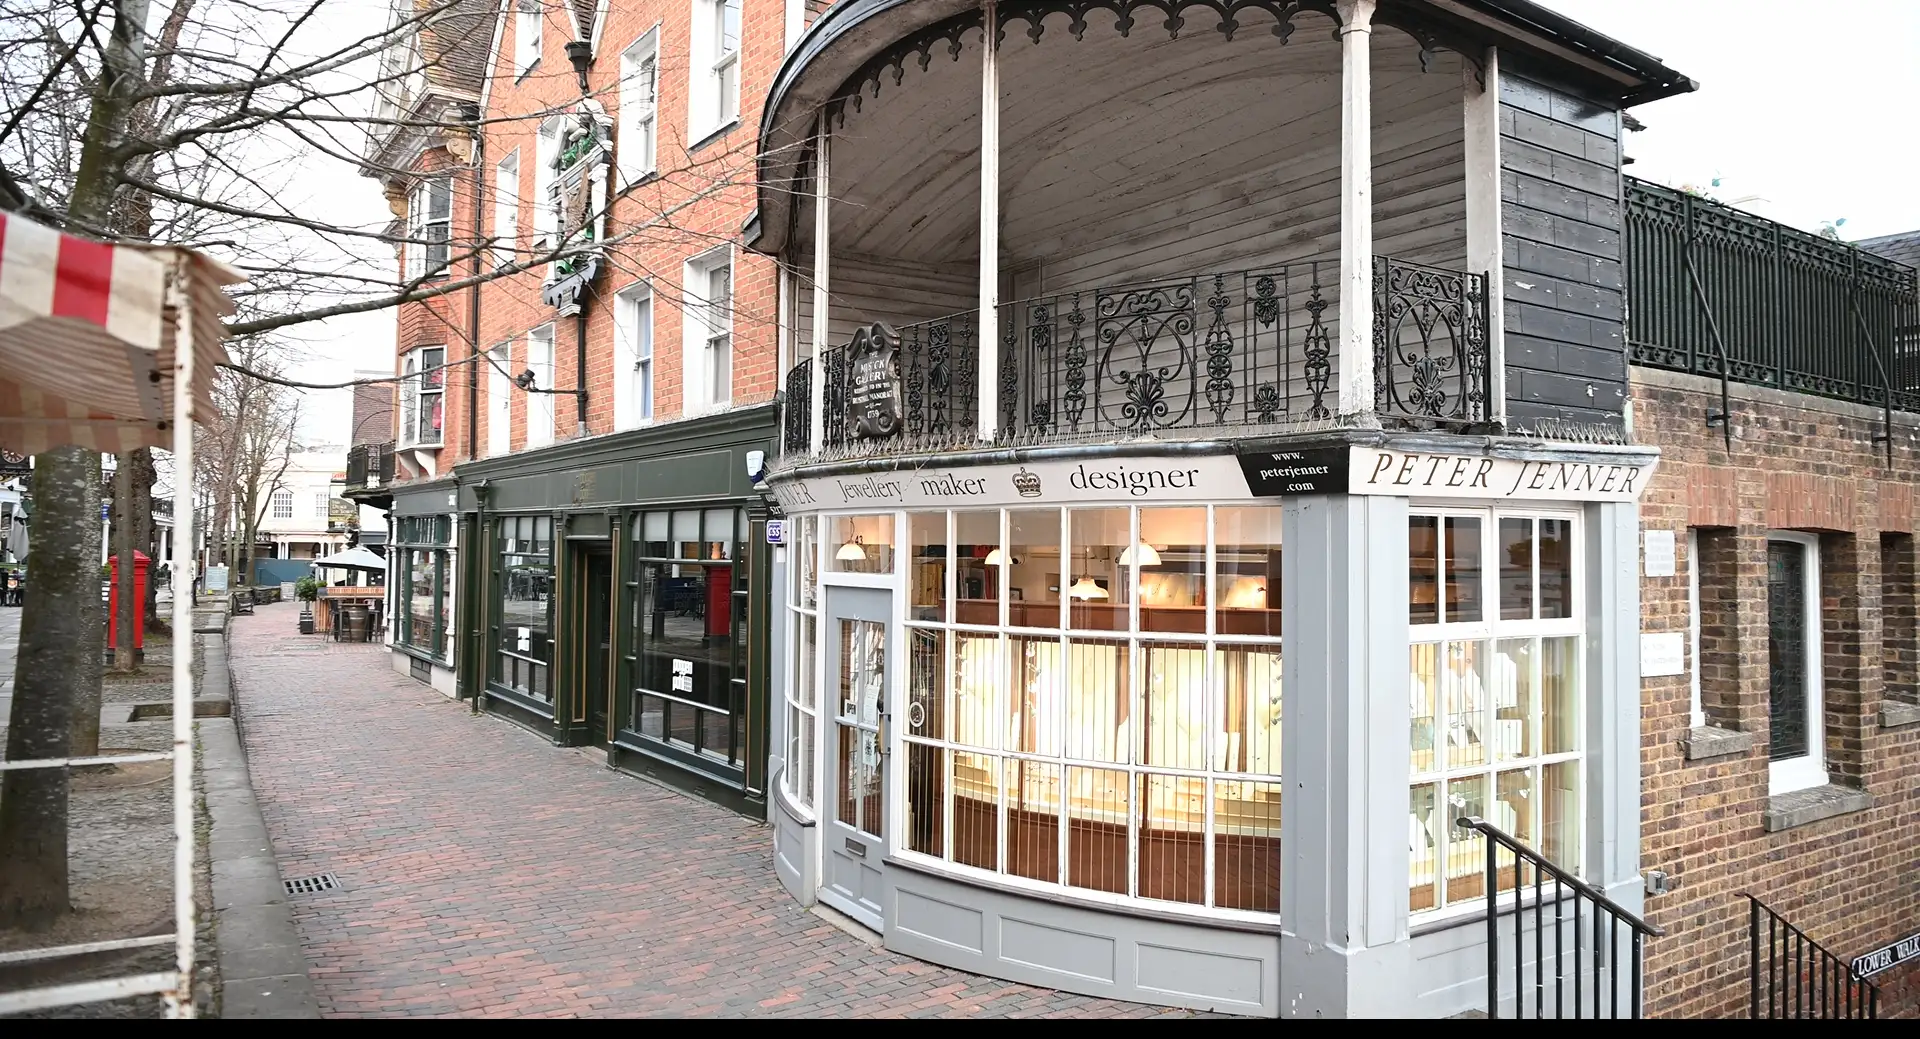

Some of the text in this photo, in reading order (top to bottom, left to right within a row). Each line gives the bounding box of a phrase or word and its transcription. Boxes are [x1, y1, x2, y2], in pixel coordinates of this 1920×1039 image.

[1272, 452, 1304, 461] www.
[837, 476, 903, 503] Jewellery
[920, 473, 986, 496] maker
[1070, 464, 1199, 496] designer
[1260, 466, 1329, 480] peterjenner
[1367, 453, 1639, 496] PETER JENNER
[1286, 482, 1315, 491] .com
[1858, 937, 1920, 975] LOWER WALK
